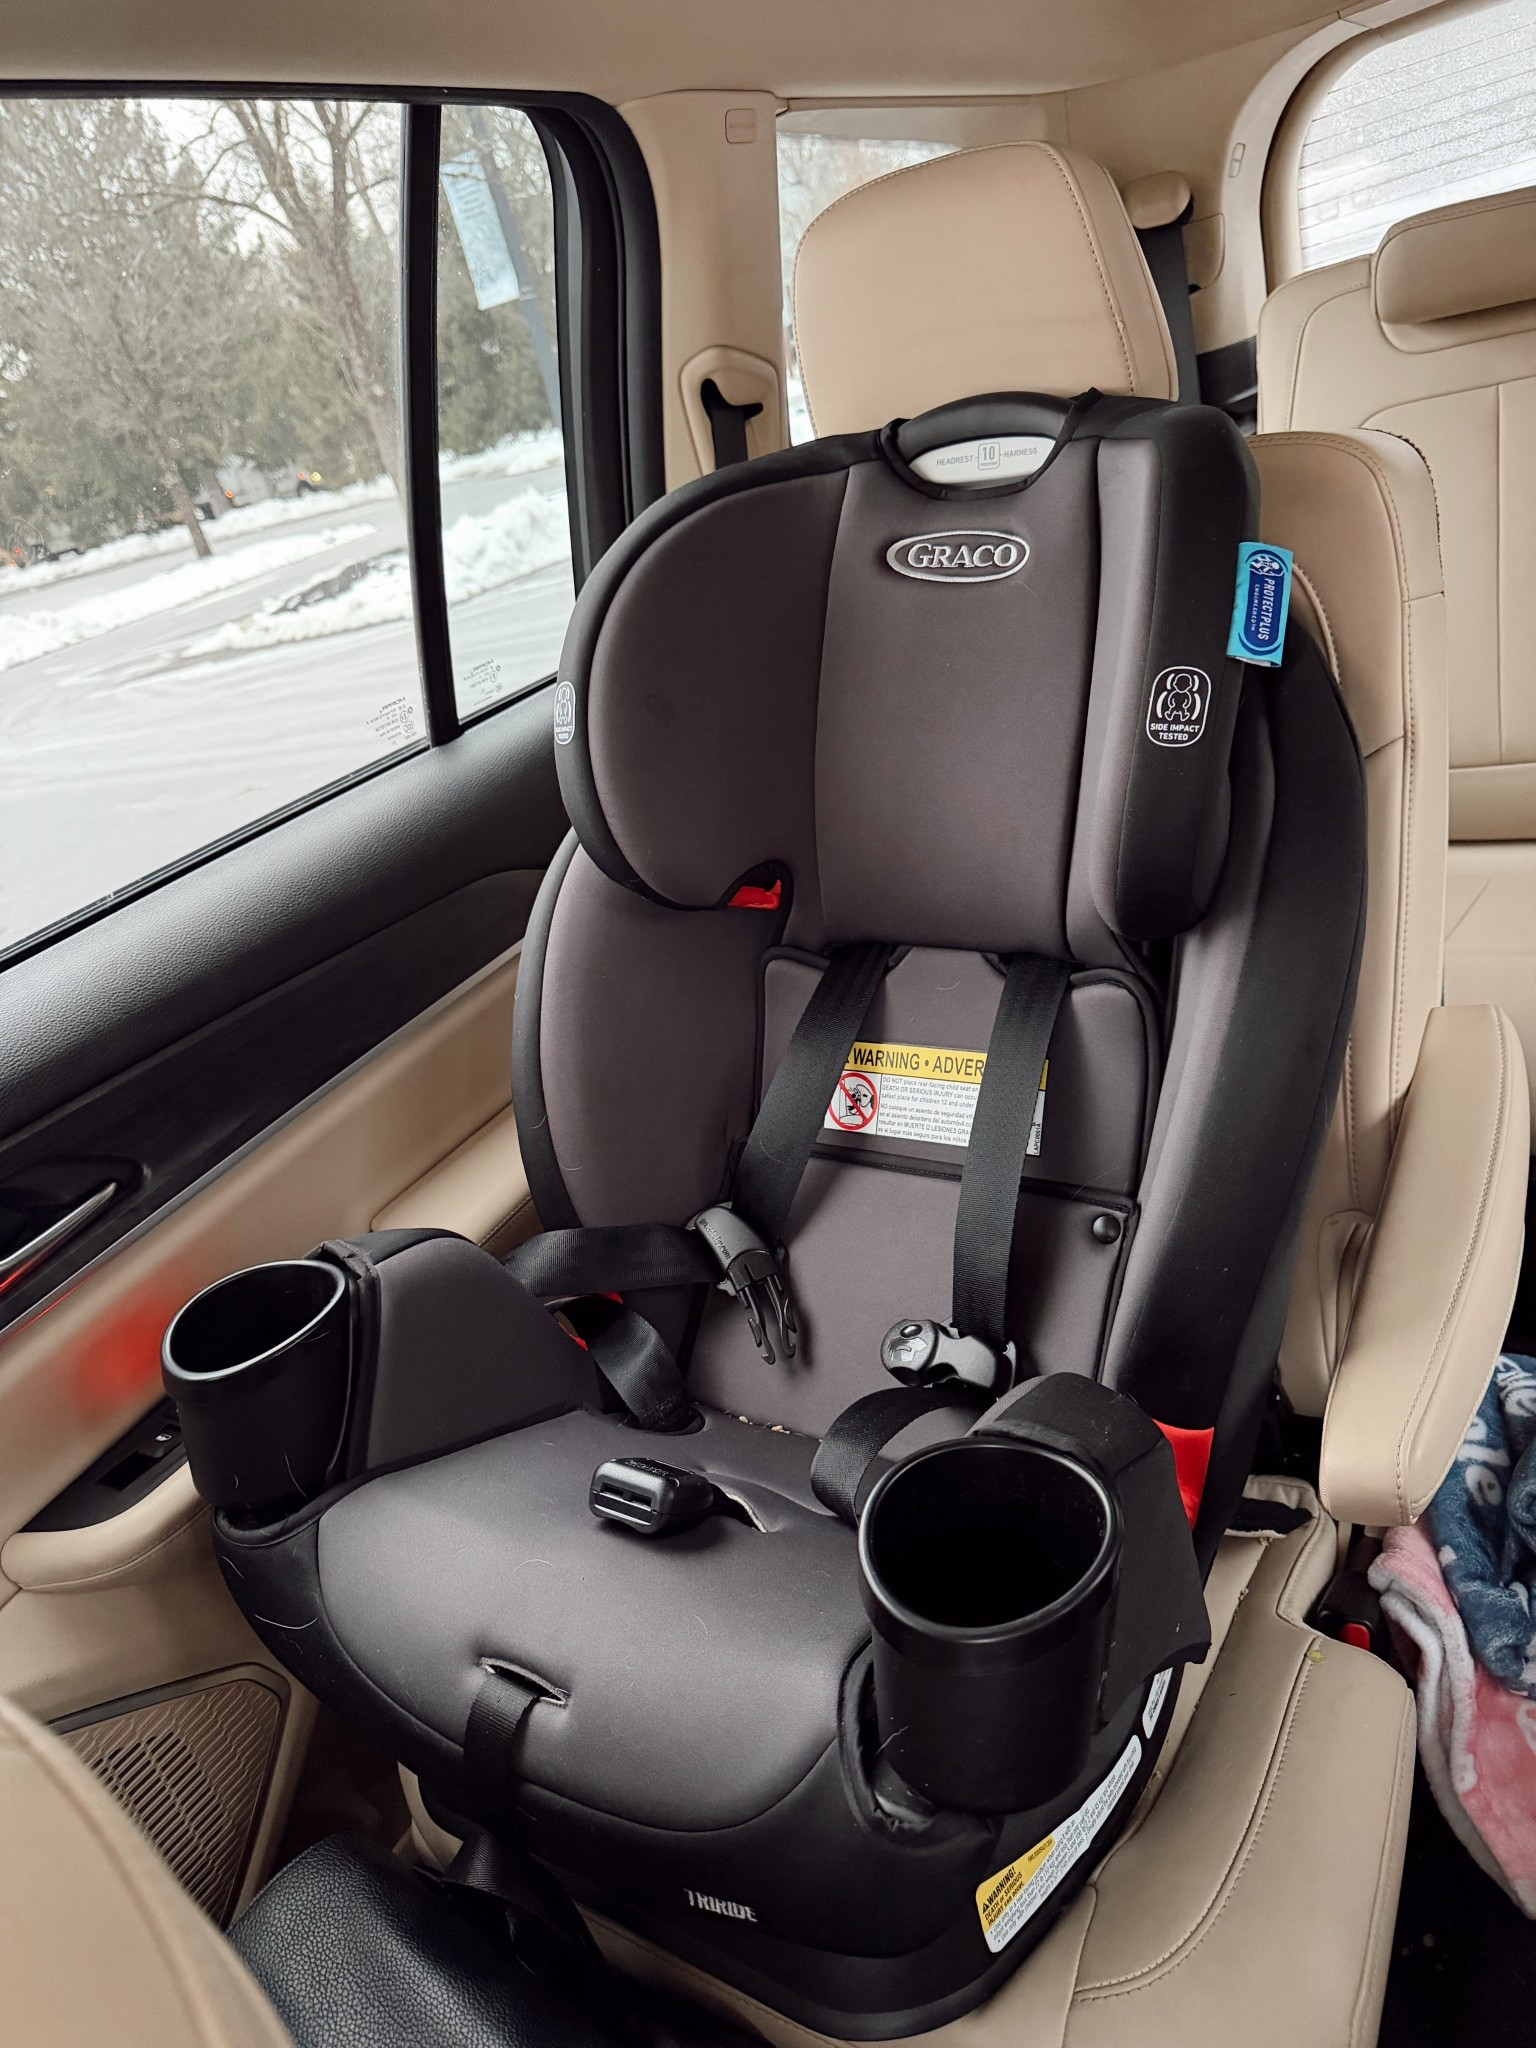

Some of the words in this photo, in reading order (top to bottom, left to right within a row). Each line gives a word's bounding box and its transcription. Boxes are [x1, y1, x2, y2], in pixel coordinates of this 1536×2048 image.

[982, 446, 995, 461] 10
[1004, 447, 1038, 458] HARNESS
[936, 455, 973, 466] HEADREST
[907, 543, 1018, 568] GRACO
[1257, 578, 1275, 641] PROTECTPLUS
[1150, 723, 1169, 731] SIDE
[1170, 724, 1200, 733] IMPACT
[1158, 732, 1189, 741] TESTED
[851, 1047, 920, 1070] WARNING
[909, 1087, 932, 1095] SERIOUS
[919, 1096, 940, 1104] children
[986, 1865, 1016, 1906] WARNING!
[984, 1899, 999, 1921] DEATH
[999, 1894, 1004, 1903] or
[1003, 1870, 1022, 1897] SERIOUS
[683, 1888, 758, 1922] TRIRIDE
